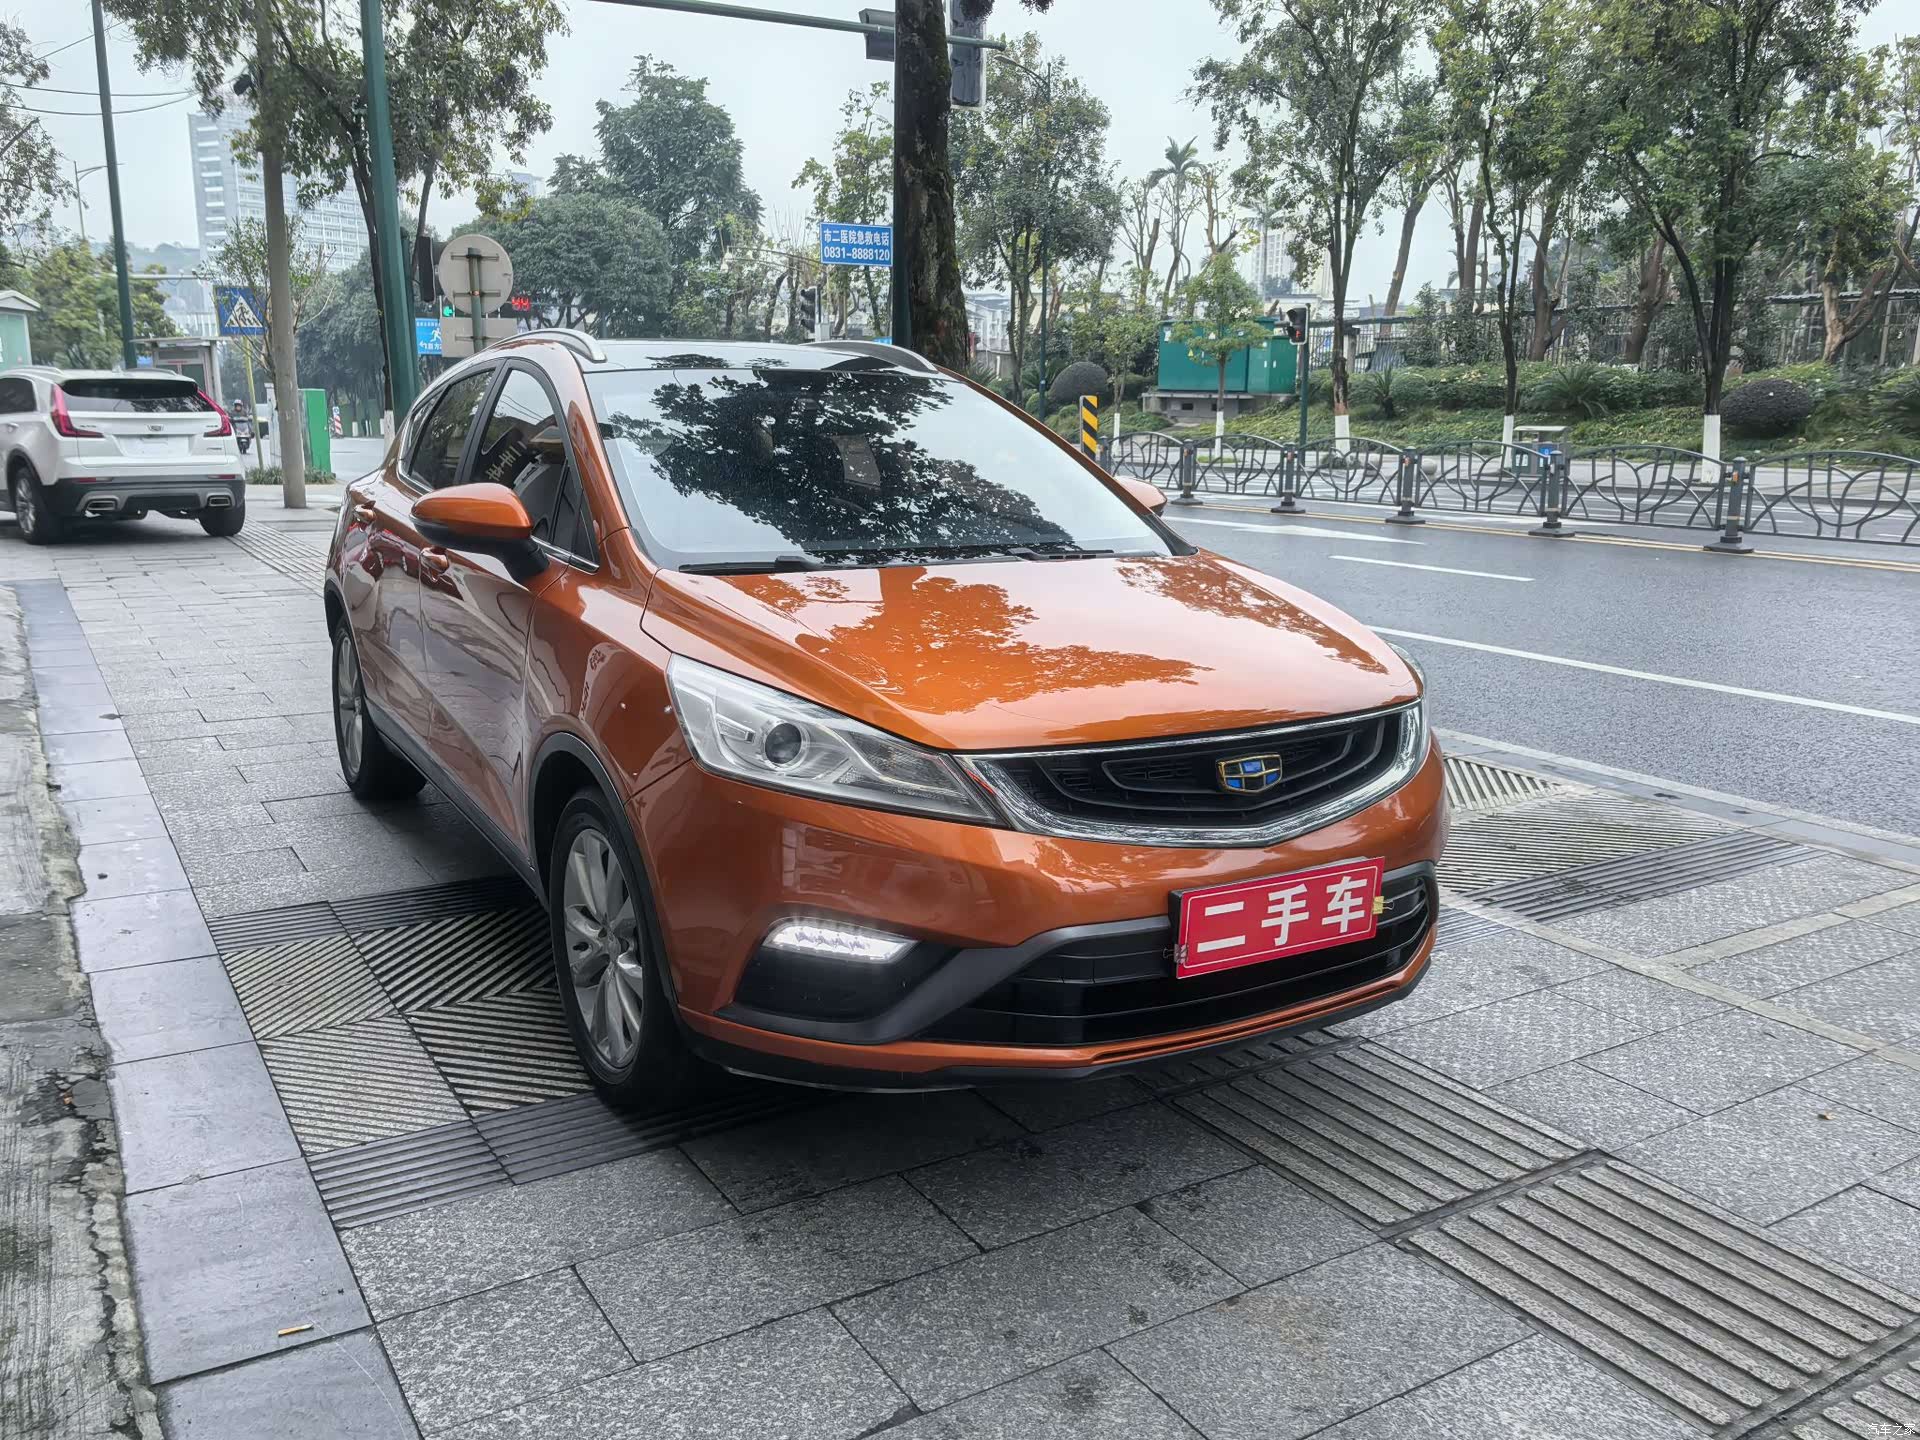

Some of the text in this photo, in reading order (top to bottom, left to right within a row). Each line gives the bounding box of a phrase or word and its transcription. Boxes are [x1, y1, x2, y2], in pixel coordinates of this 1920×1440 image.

[824, 228, 889, 246] 市二医院急救电话
[824, 247, 890, 261] 0831-8888120
[1197, 876, 1368, 952] 二手车
